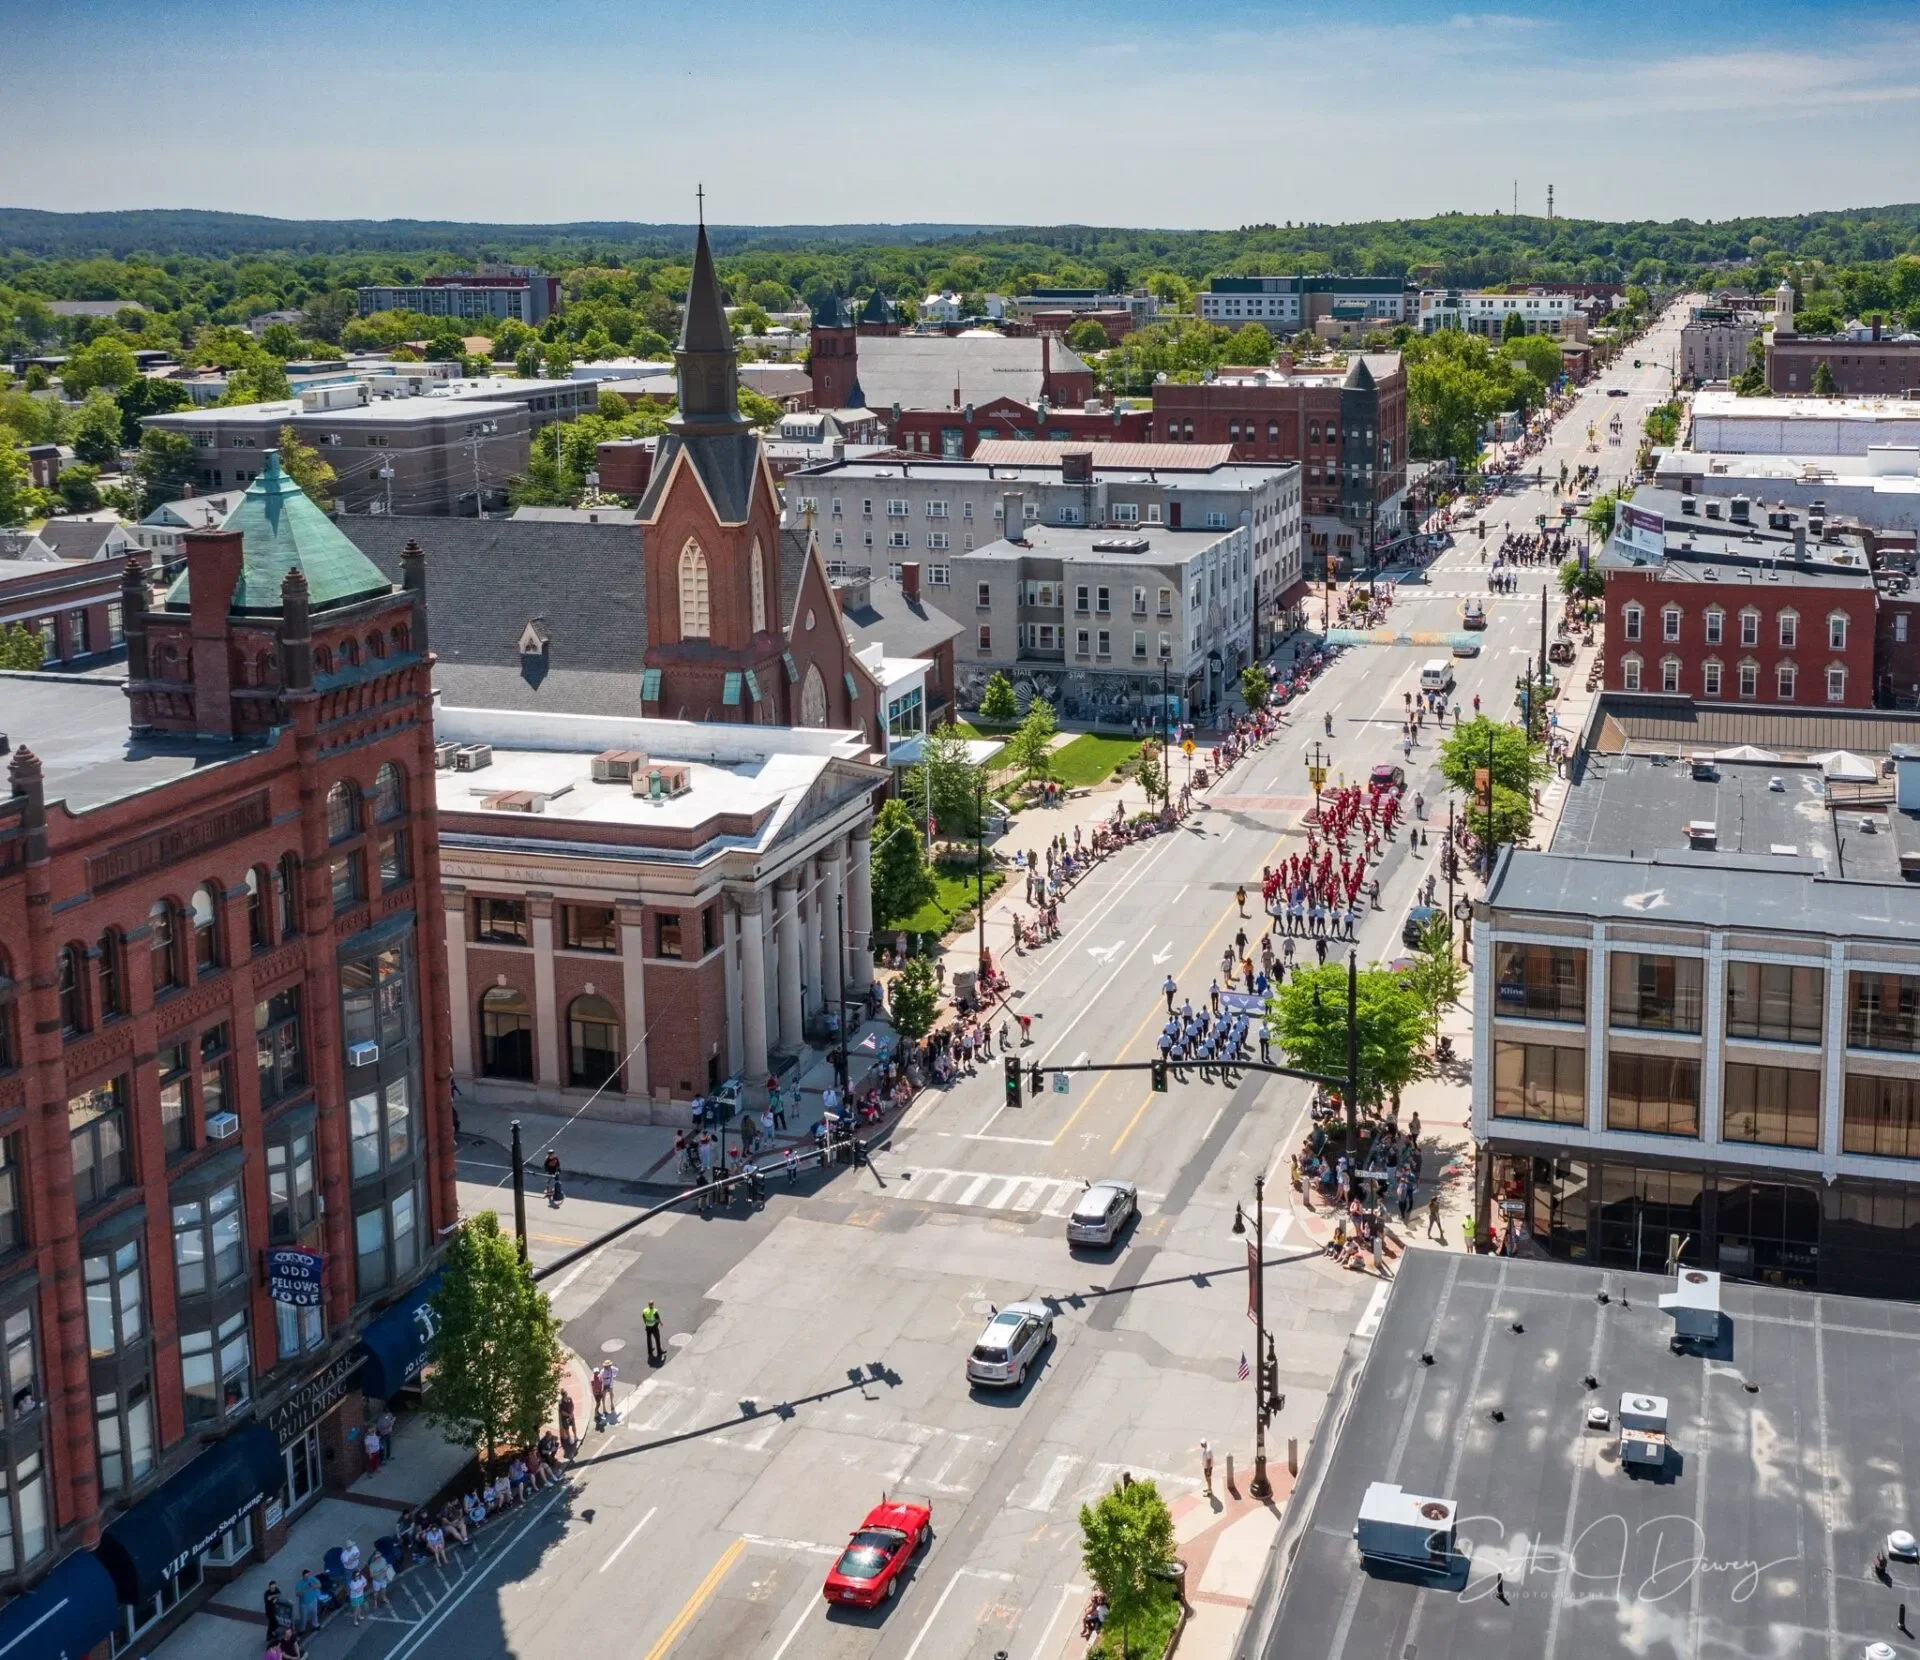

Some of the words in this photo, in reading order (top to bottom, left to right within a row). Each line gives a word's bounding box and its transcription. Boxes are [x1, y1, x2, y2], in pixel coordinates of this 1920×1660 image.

[444, 864, 486, 877] ONAL
[504, 868, 547, 882] BANK
[272, 1277, 319, 1293] FELLOWS
[281, 1265, 310, 1278] ODD
[269, 1352, 355, 1432] LANDMARK
[280, 1380, 347, 1443] BUILDING
[161, 1550, 189, 1580] VIP
[192, 1530, 219, 1556] Barber
[218, 1515, 237, 1533] Shop
